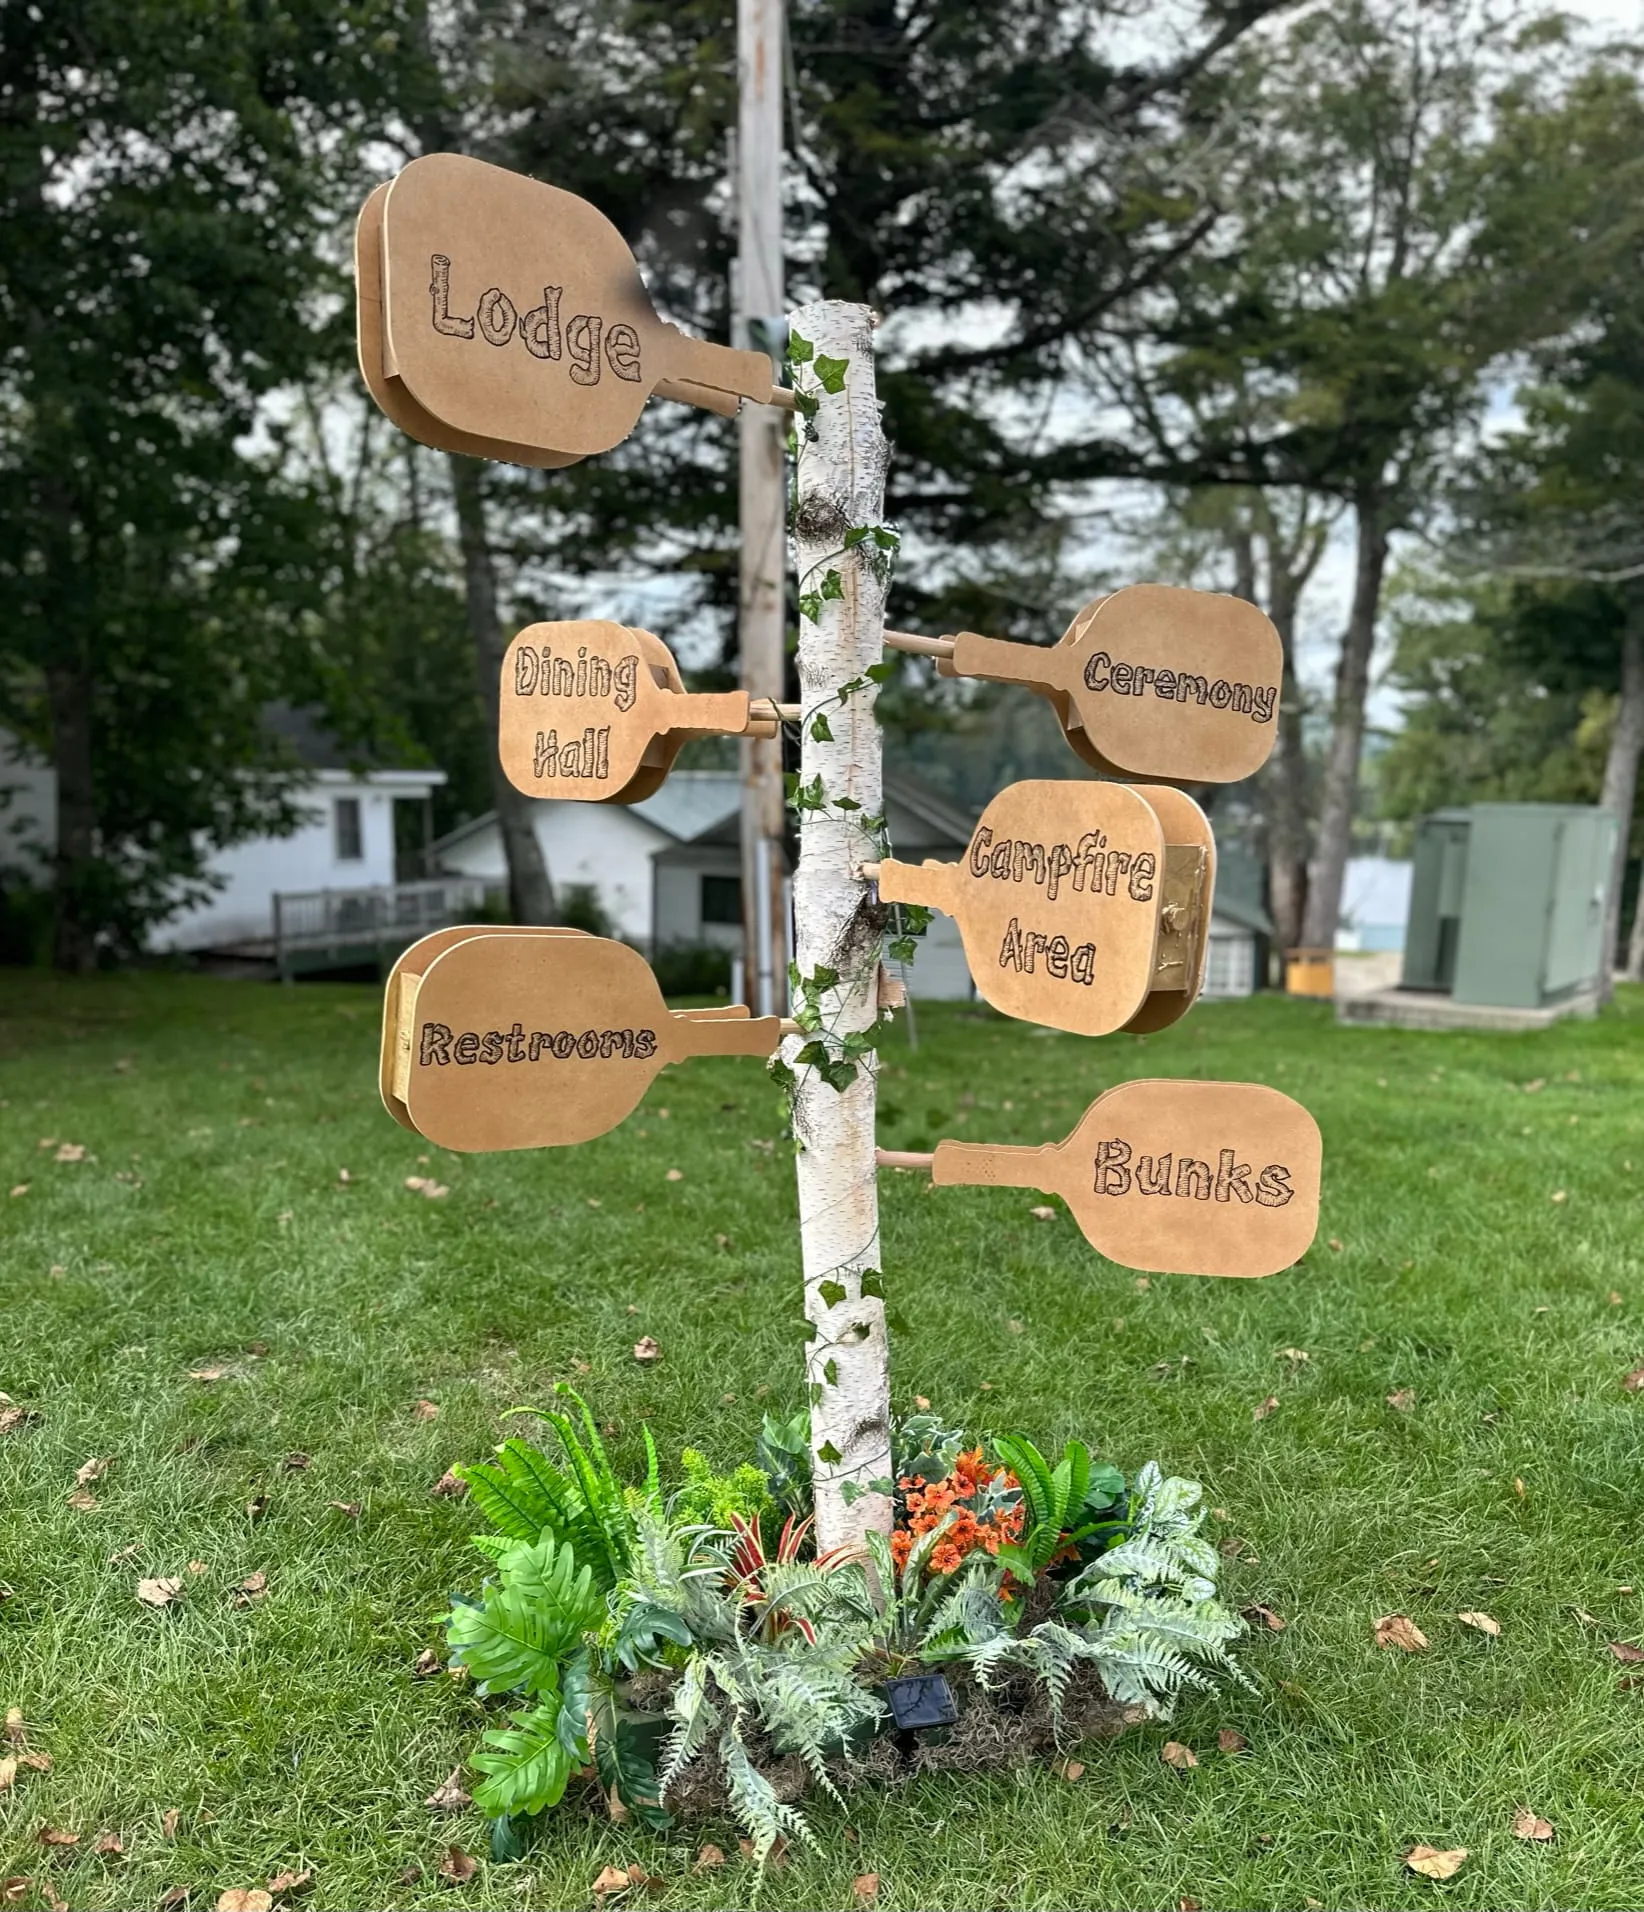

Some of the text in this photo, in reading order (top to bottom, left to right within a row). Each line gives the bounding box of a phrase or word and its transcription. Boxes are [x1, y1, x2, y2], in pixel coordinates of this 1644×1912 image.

[429, 254, 642, 386] Lodge
[515, 646, 639, 713] Dining
[1083, 651, 1277, 723] Ceremony
[533, 725, 611, 779] Hall
[970, 826, 1156, 902] Campfire
[999, 917, 1096, 985] Area
[419, 1023, 658, 1066] Restrooms
[1094, 1138, 1294, 1207] Bunks
